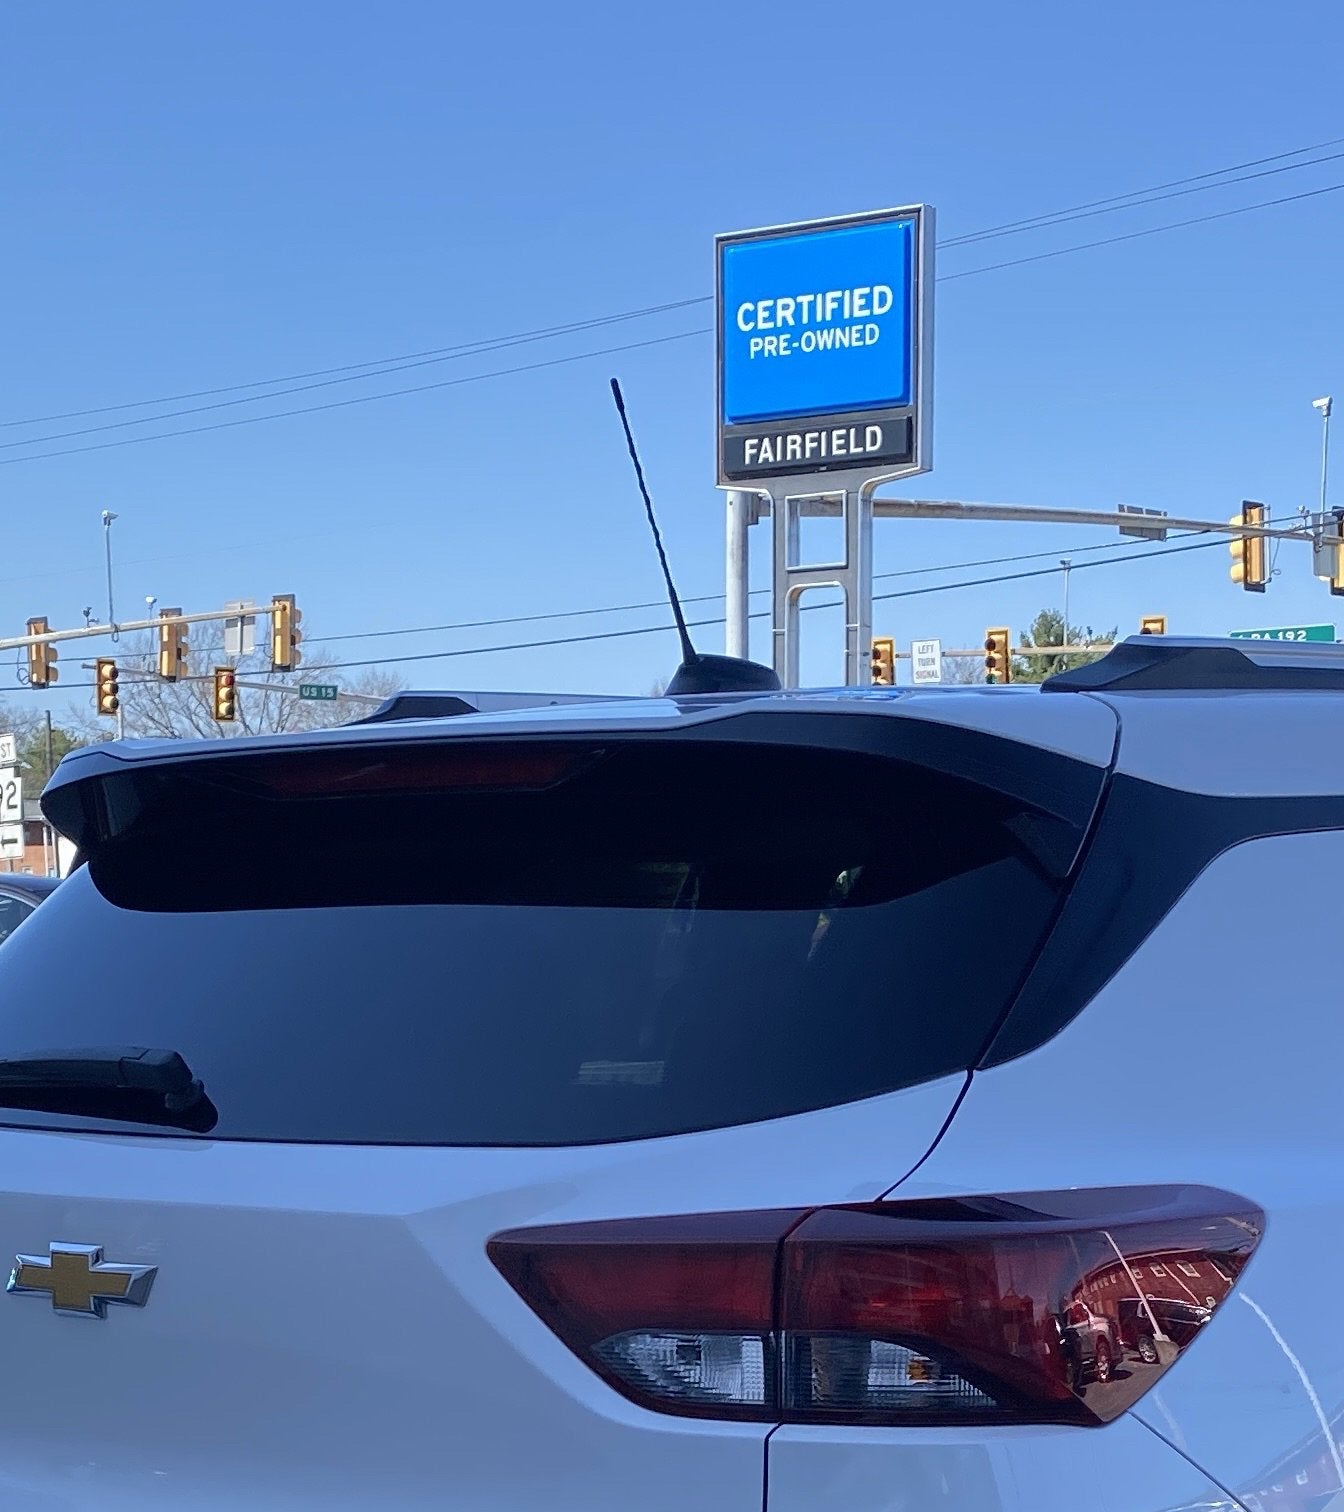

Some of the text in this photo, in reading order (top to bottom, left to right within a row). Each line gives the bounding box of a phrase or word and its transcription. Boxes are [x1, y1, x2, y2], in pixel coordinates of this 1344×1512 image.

[736, 285, 894, 332] CERTIFIED
[749, 323, 881, 360] PRE-OWNED
[744, 425, 883, 466] FAIRFIELD
[1277, 630, 1307, 641] 192
[917, 644, 934, 655] LEFT
[302, 686, 318, 697] US
